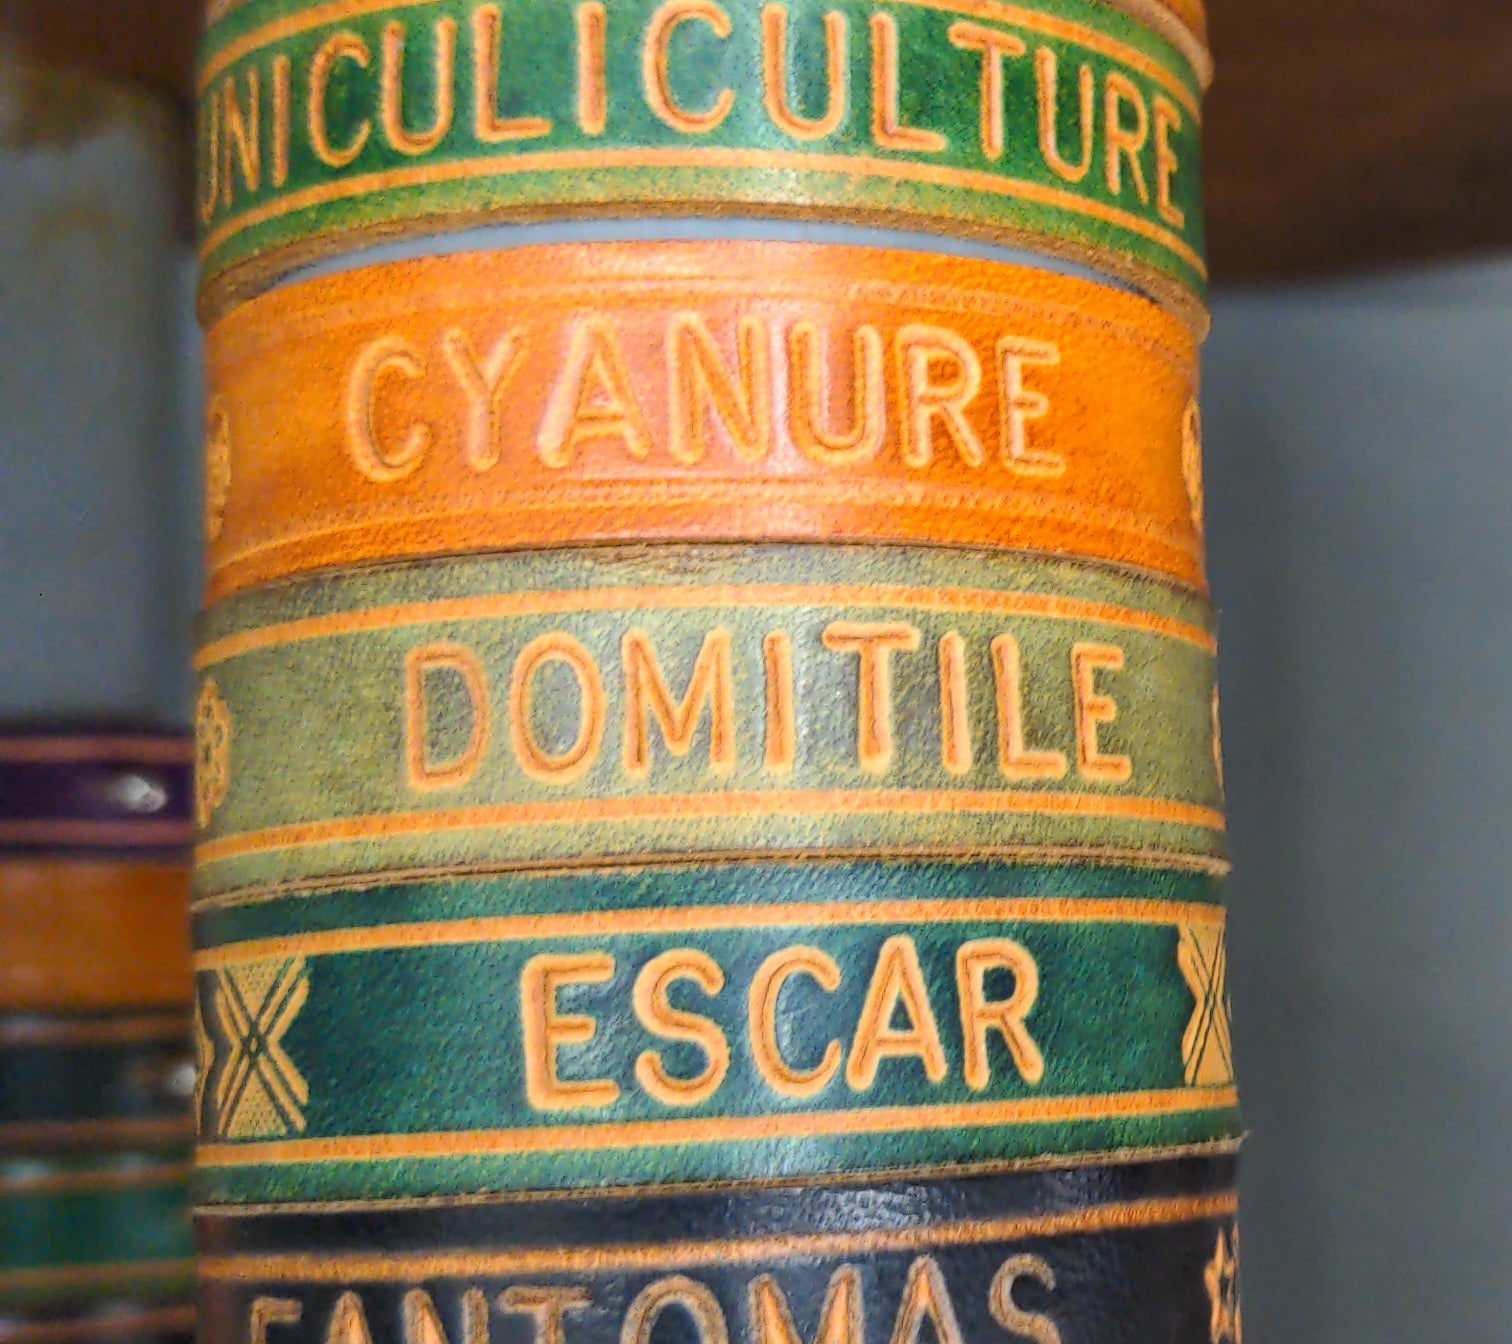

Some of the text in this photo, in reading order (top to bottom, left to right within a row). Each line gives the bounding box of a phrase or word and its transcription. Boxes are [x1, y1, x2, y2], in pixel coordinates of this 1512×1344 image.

[347, 310, 1067, 483] CYANURE
[404, 620, 1132, 793] DOMITILE
[519, 934, 1045, 1110] ESCAR
